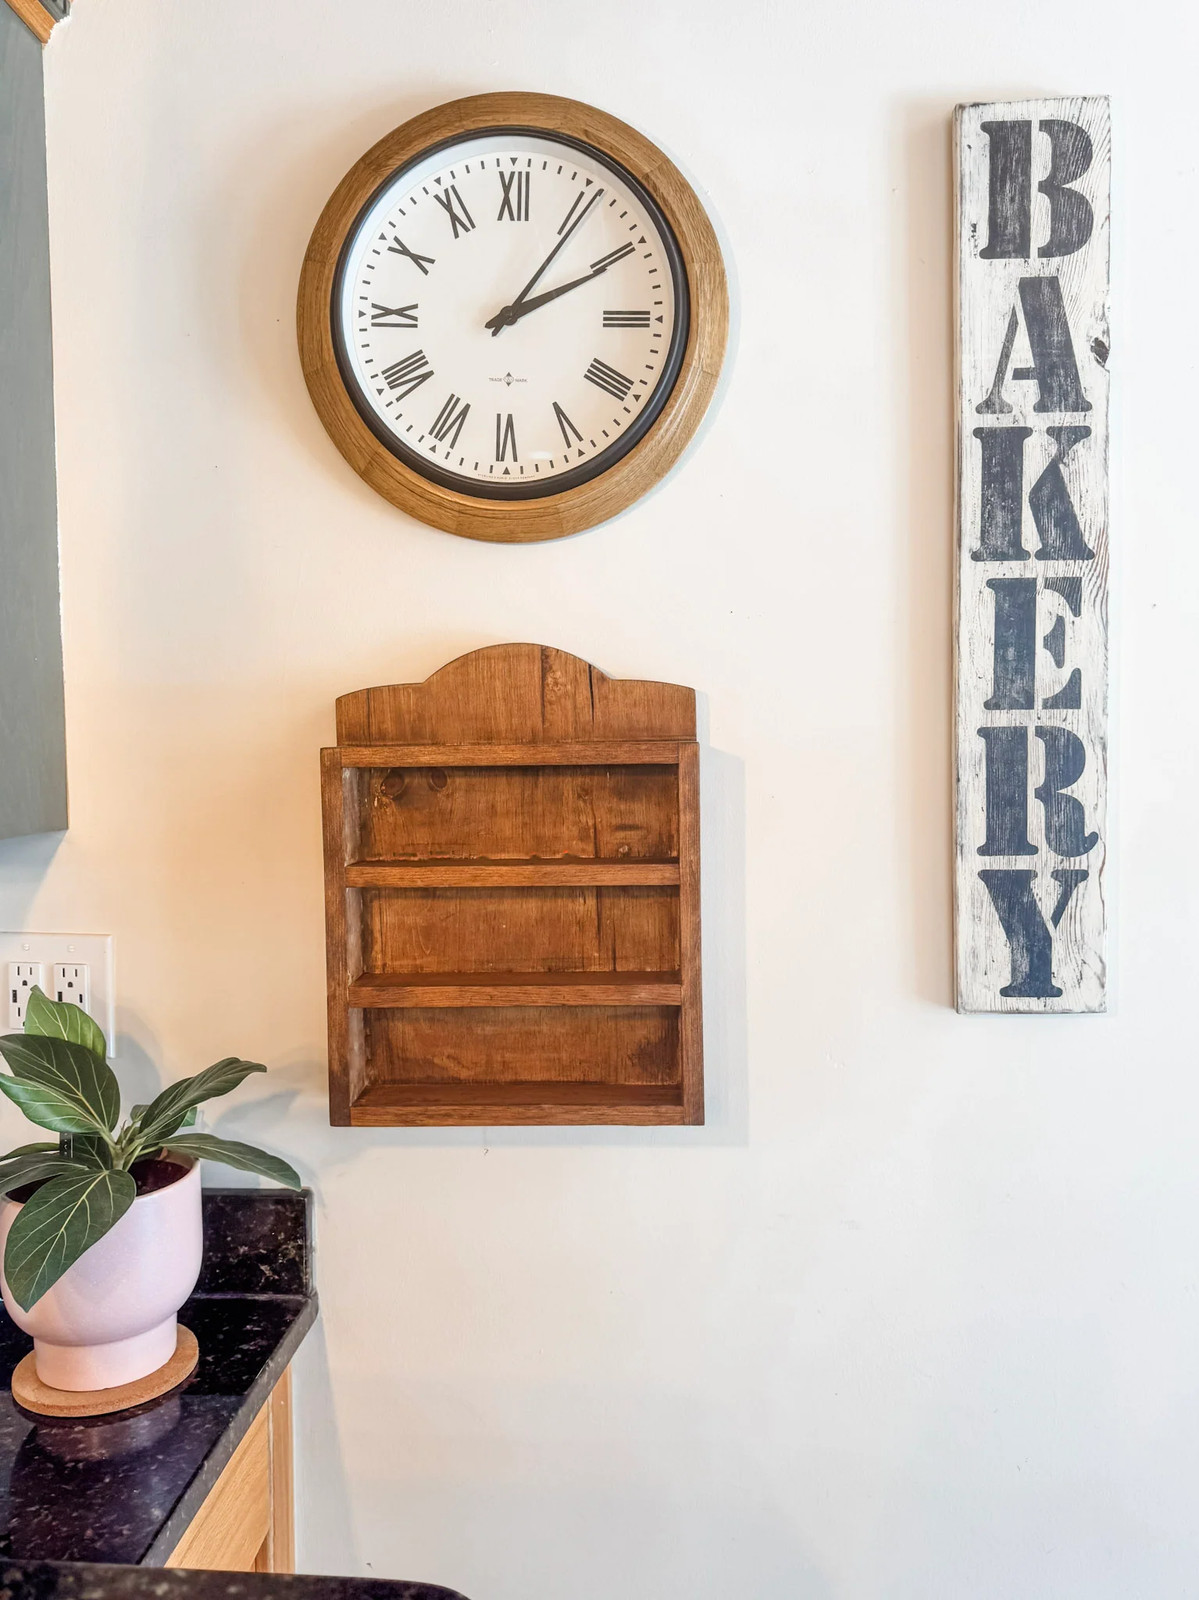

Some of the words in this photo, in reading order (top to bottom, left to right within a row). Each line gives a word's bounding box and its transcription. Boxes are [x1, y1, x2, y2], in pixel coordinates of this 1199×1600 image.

[433, 184, 476, 240] XI
[497, 170, 531, 222] XII
[387, 235, 436, 276] X
[589, 241, 637, 274] II
[371, 302, 419, 329] IX
[602, 310, 651, 328] III
[381, 349, 435, 403] VIII
[583, 357, 635, 402] IIII
[428, 393, 471, 450] VII
[495, 413, 518, 463] VI
[552, 401, 584, 449] V
[971, 120, 1099, 998] BAKERY
